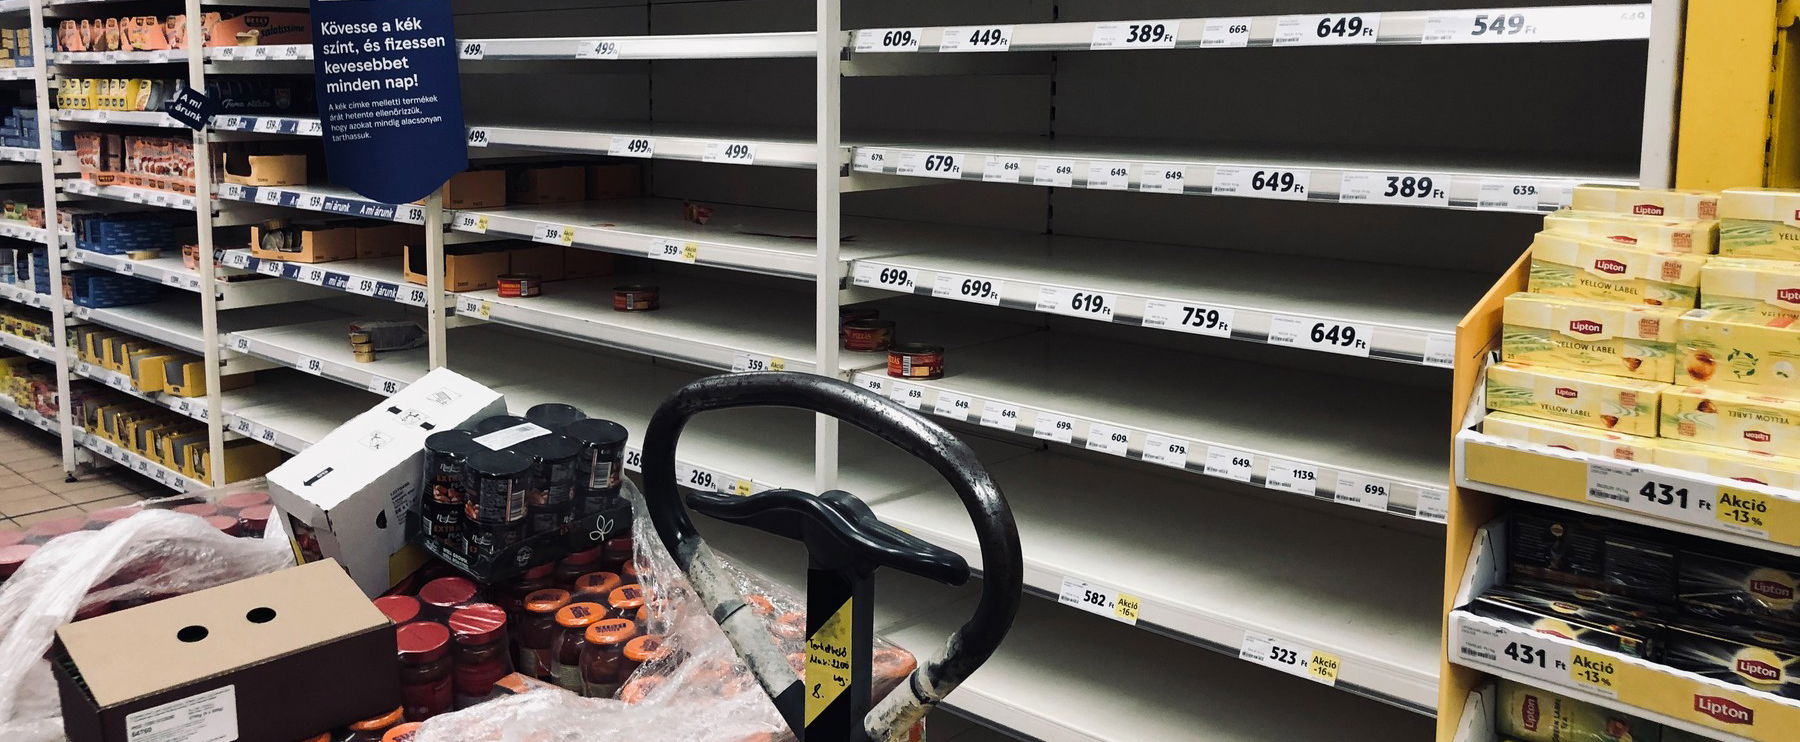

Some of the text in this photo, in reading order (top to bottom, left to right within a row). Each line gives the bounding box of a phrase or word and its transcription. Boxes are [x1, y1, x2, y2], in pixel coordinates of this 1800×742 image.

[321, 17, 422, 36] Kövesse a kék
[323, 36, 446, 55] színt, és fizessen
[324, 57, 409, 74] kevesebbet
[326, 73, 418, 94] minden nap!
[180, 93, 203, 110] A mi
[335, 101, 347, 110] kék
[371, 98, 401, 107] melletti
[402, 95, 438, 105] termékek
[175, 103, 202, 123] árunk
[345, 111, 374, 121] hetente
[331, 115, 442, 133] hogy azokat mindig alacsonyan
[332, 132, 372, 142] tarthassuk.
[375, 206, 394, 218] árunk
[1635, 206, 1662, 215] Lipton
[663, 245, 678, 255] 359
[1597, 261, 1625, 273] Lipton
[1580, 279, 1639, 296] YELLOW LABEL
[1572, 321, 1601, 332] Lipton
[1591, 345, 1617, 355] LABEL
[748, 359, 763, 371] 359
[1556, 388, 1577, 397] Lipton
[1540, 403, 1592, 417] YELLOW LABEL
[1756, 414, 1789, 425] YELLOW
[1639, 481, 1689, 509] 431
[1699, 499, 1712, 511] Ft
[1719, 492, 1768, 514] Akció
[1754, 582, 1790, 596] Lipton
[1083, 590, 1115, 609] 582 Ft
[1118, 598, 1138, 610] Akció
[1270, 646, 1308, 668] 523 Ft
[1312, 655, 1337, 670] Akció
[1504, 641, 1547, 668] 431
[1555, 660, 1566, 671] Ft
[1572, 654, 1614, 675] Akció
[1740, 661, 1777, 678] Lipton
[1525, 698, 1536, 728] Lipton
[1698, 697, 1749, 721] Lipton
